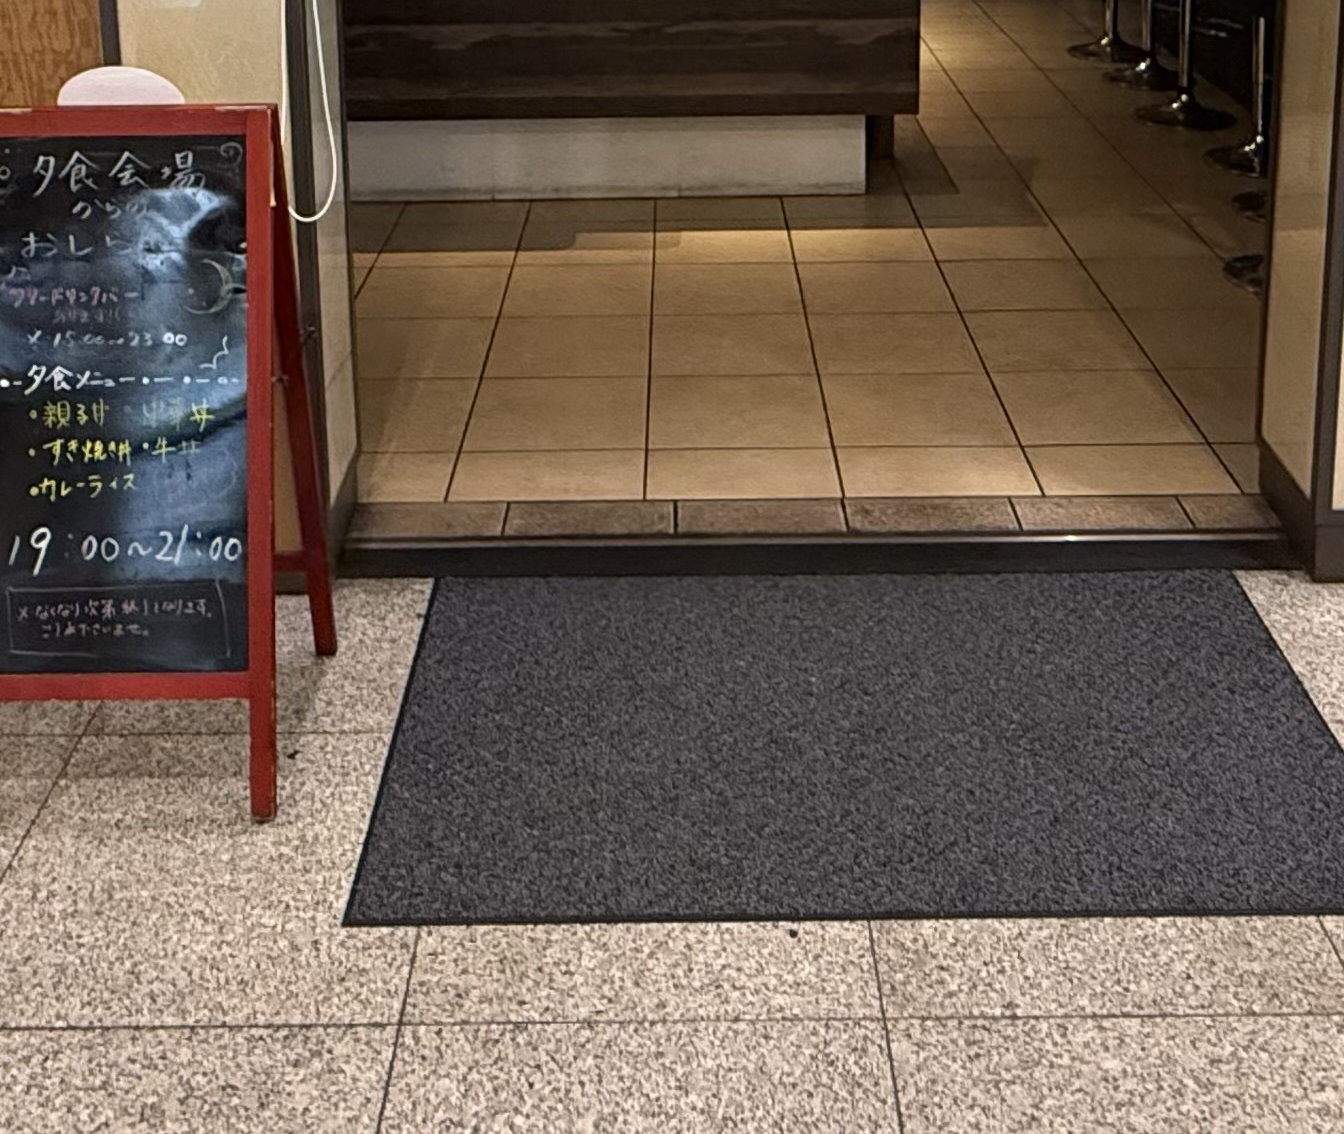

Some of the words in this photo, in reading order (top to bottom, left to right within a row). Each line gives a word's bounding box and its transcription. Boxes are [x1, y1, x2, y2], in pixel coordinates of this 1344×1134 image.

[32, 150, 205, 197] 夕食会場
[42, 399, 109, 429] 親子丼
[42, 436, 132, 466] すき焼き丼
[150, 436, 201, 463] 牛丼
[38, 472, 137, 502] カレーライス
